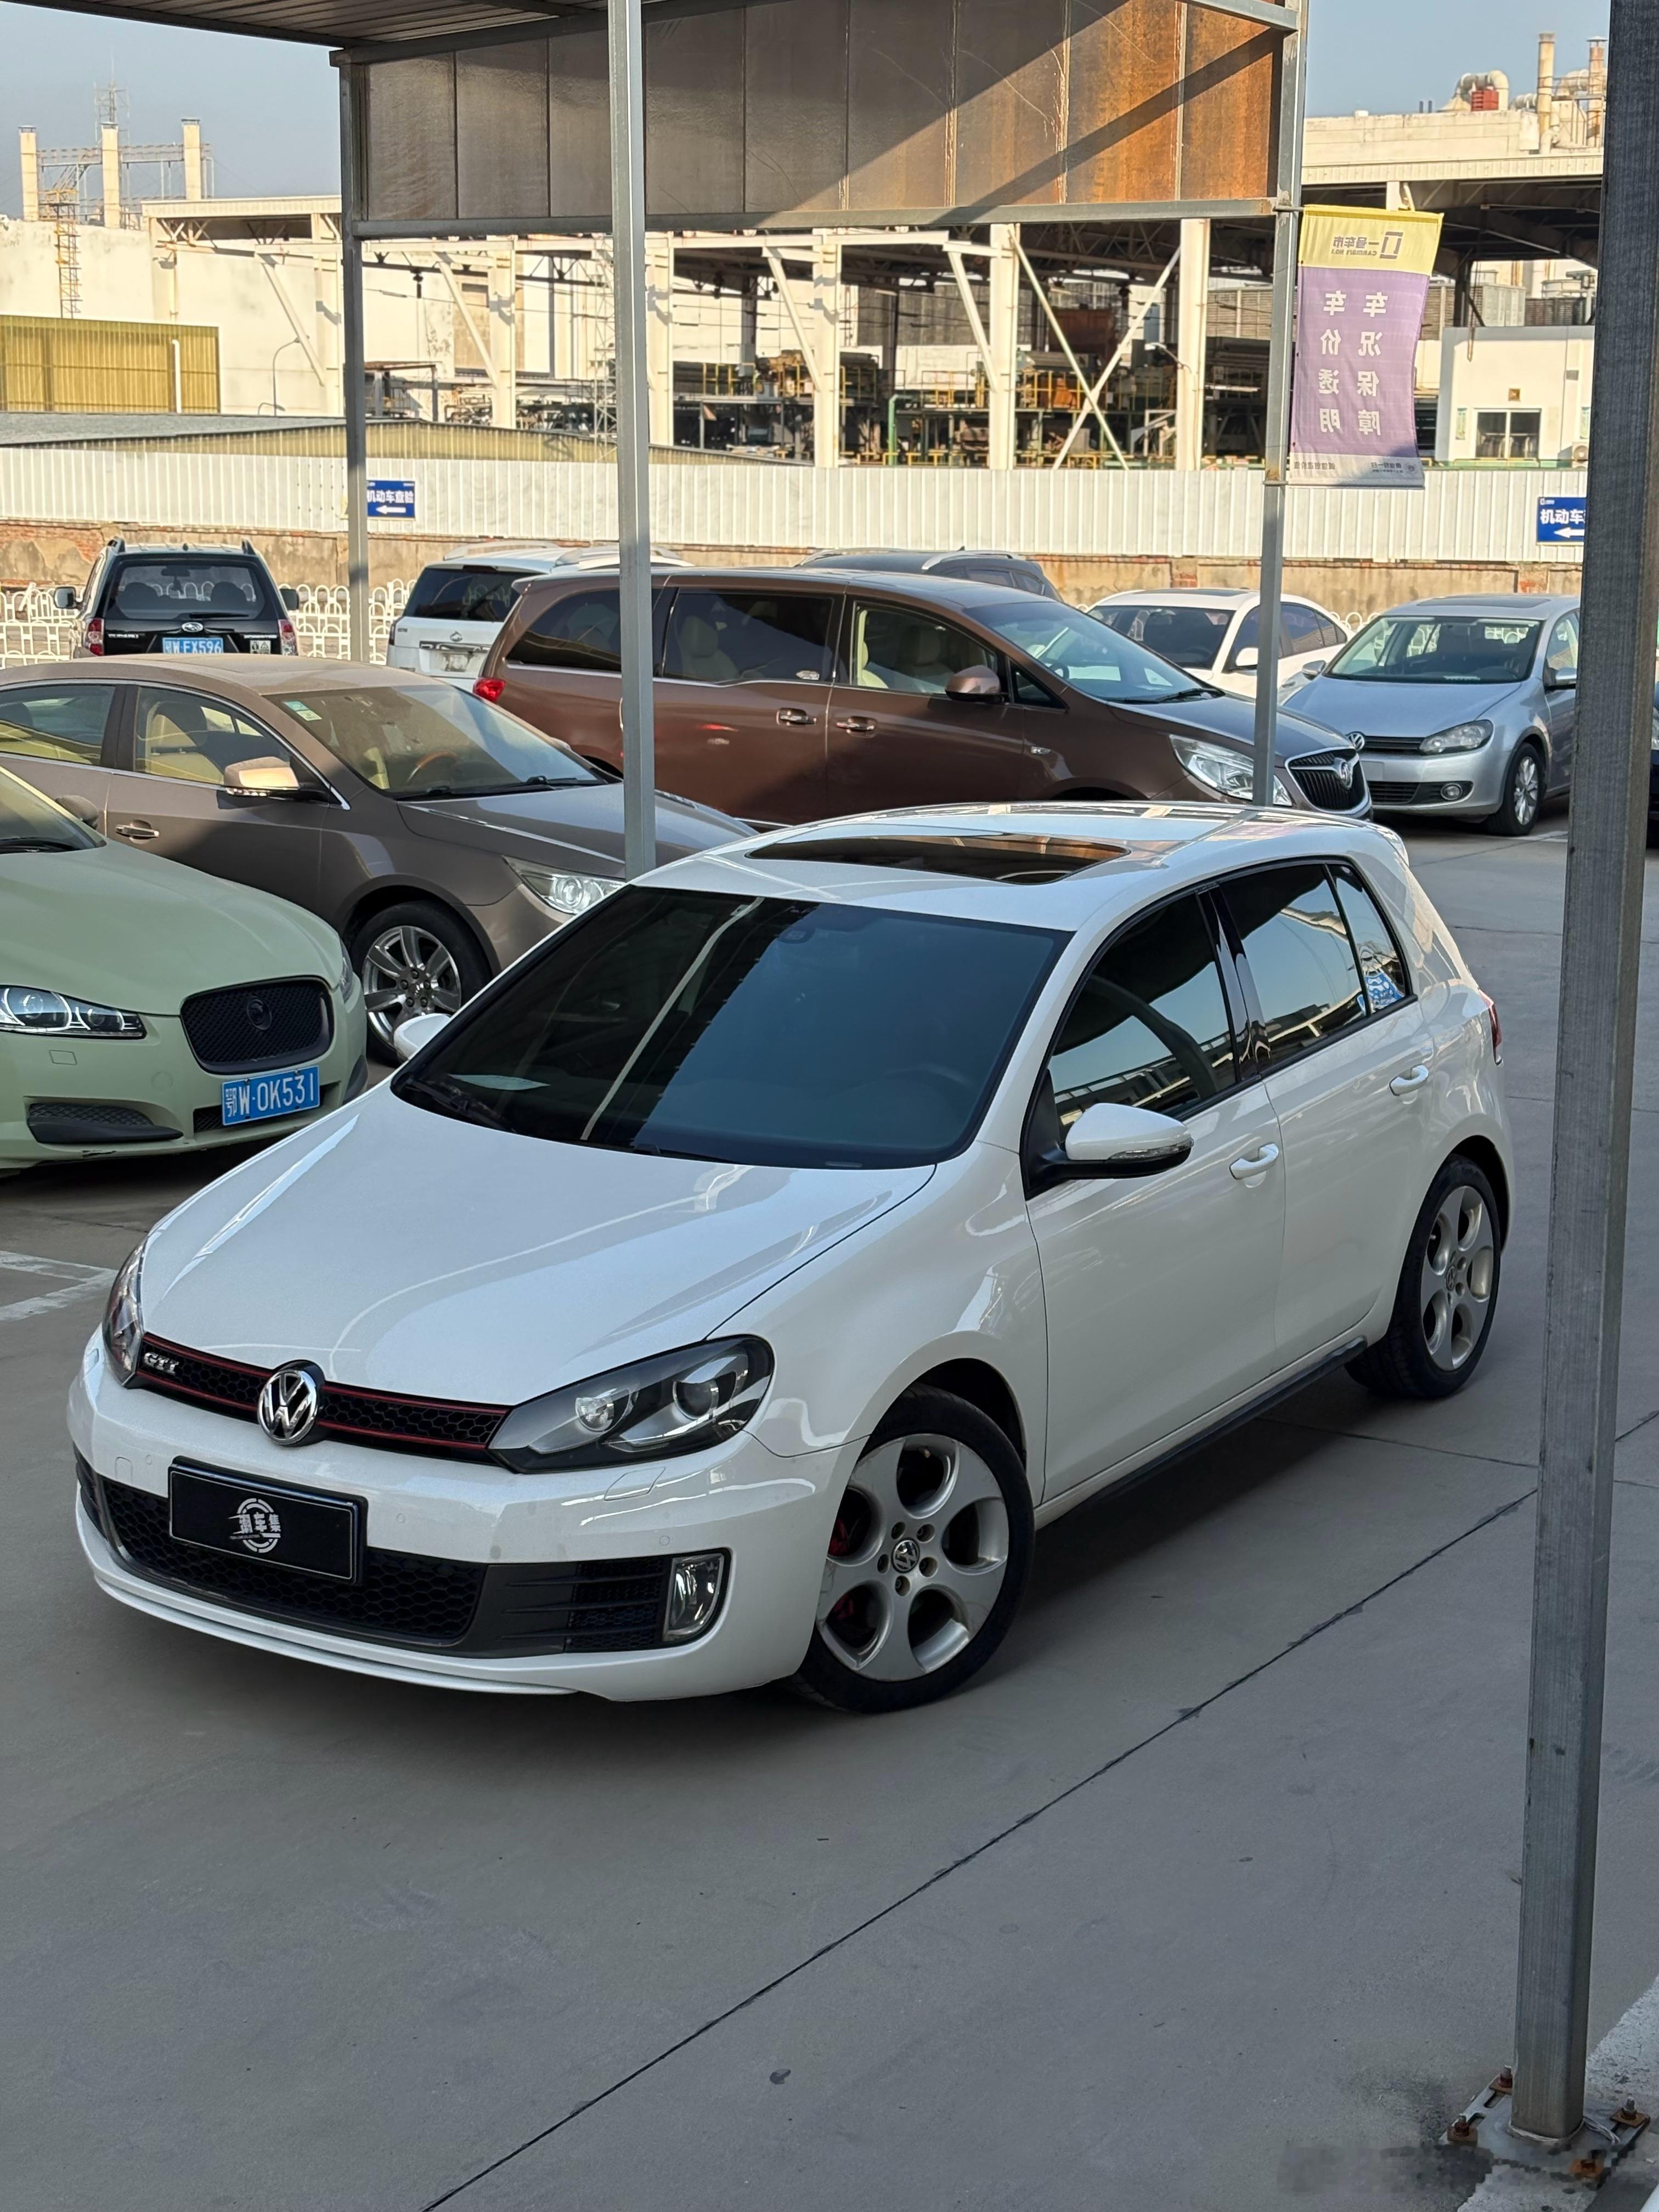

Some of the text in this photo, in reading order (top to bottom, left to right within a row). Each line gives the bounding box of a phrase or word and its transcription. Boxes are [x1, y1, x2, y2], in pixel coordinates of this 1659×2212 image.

[1540, 509, 1585, 524] 机动车
[144, 1352, 179, 1375] GTI
